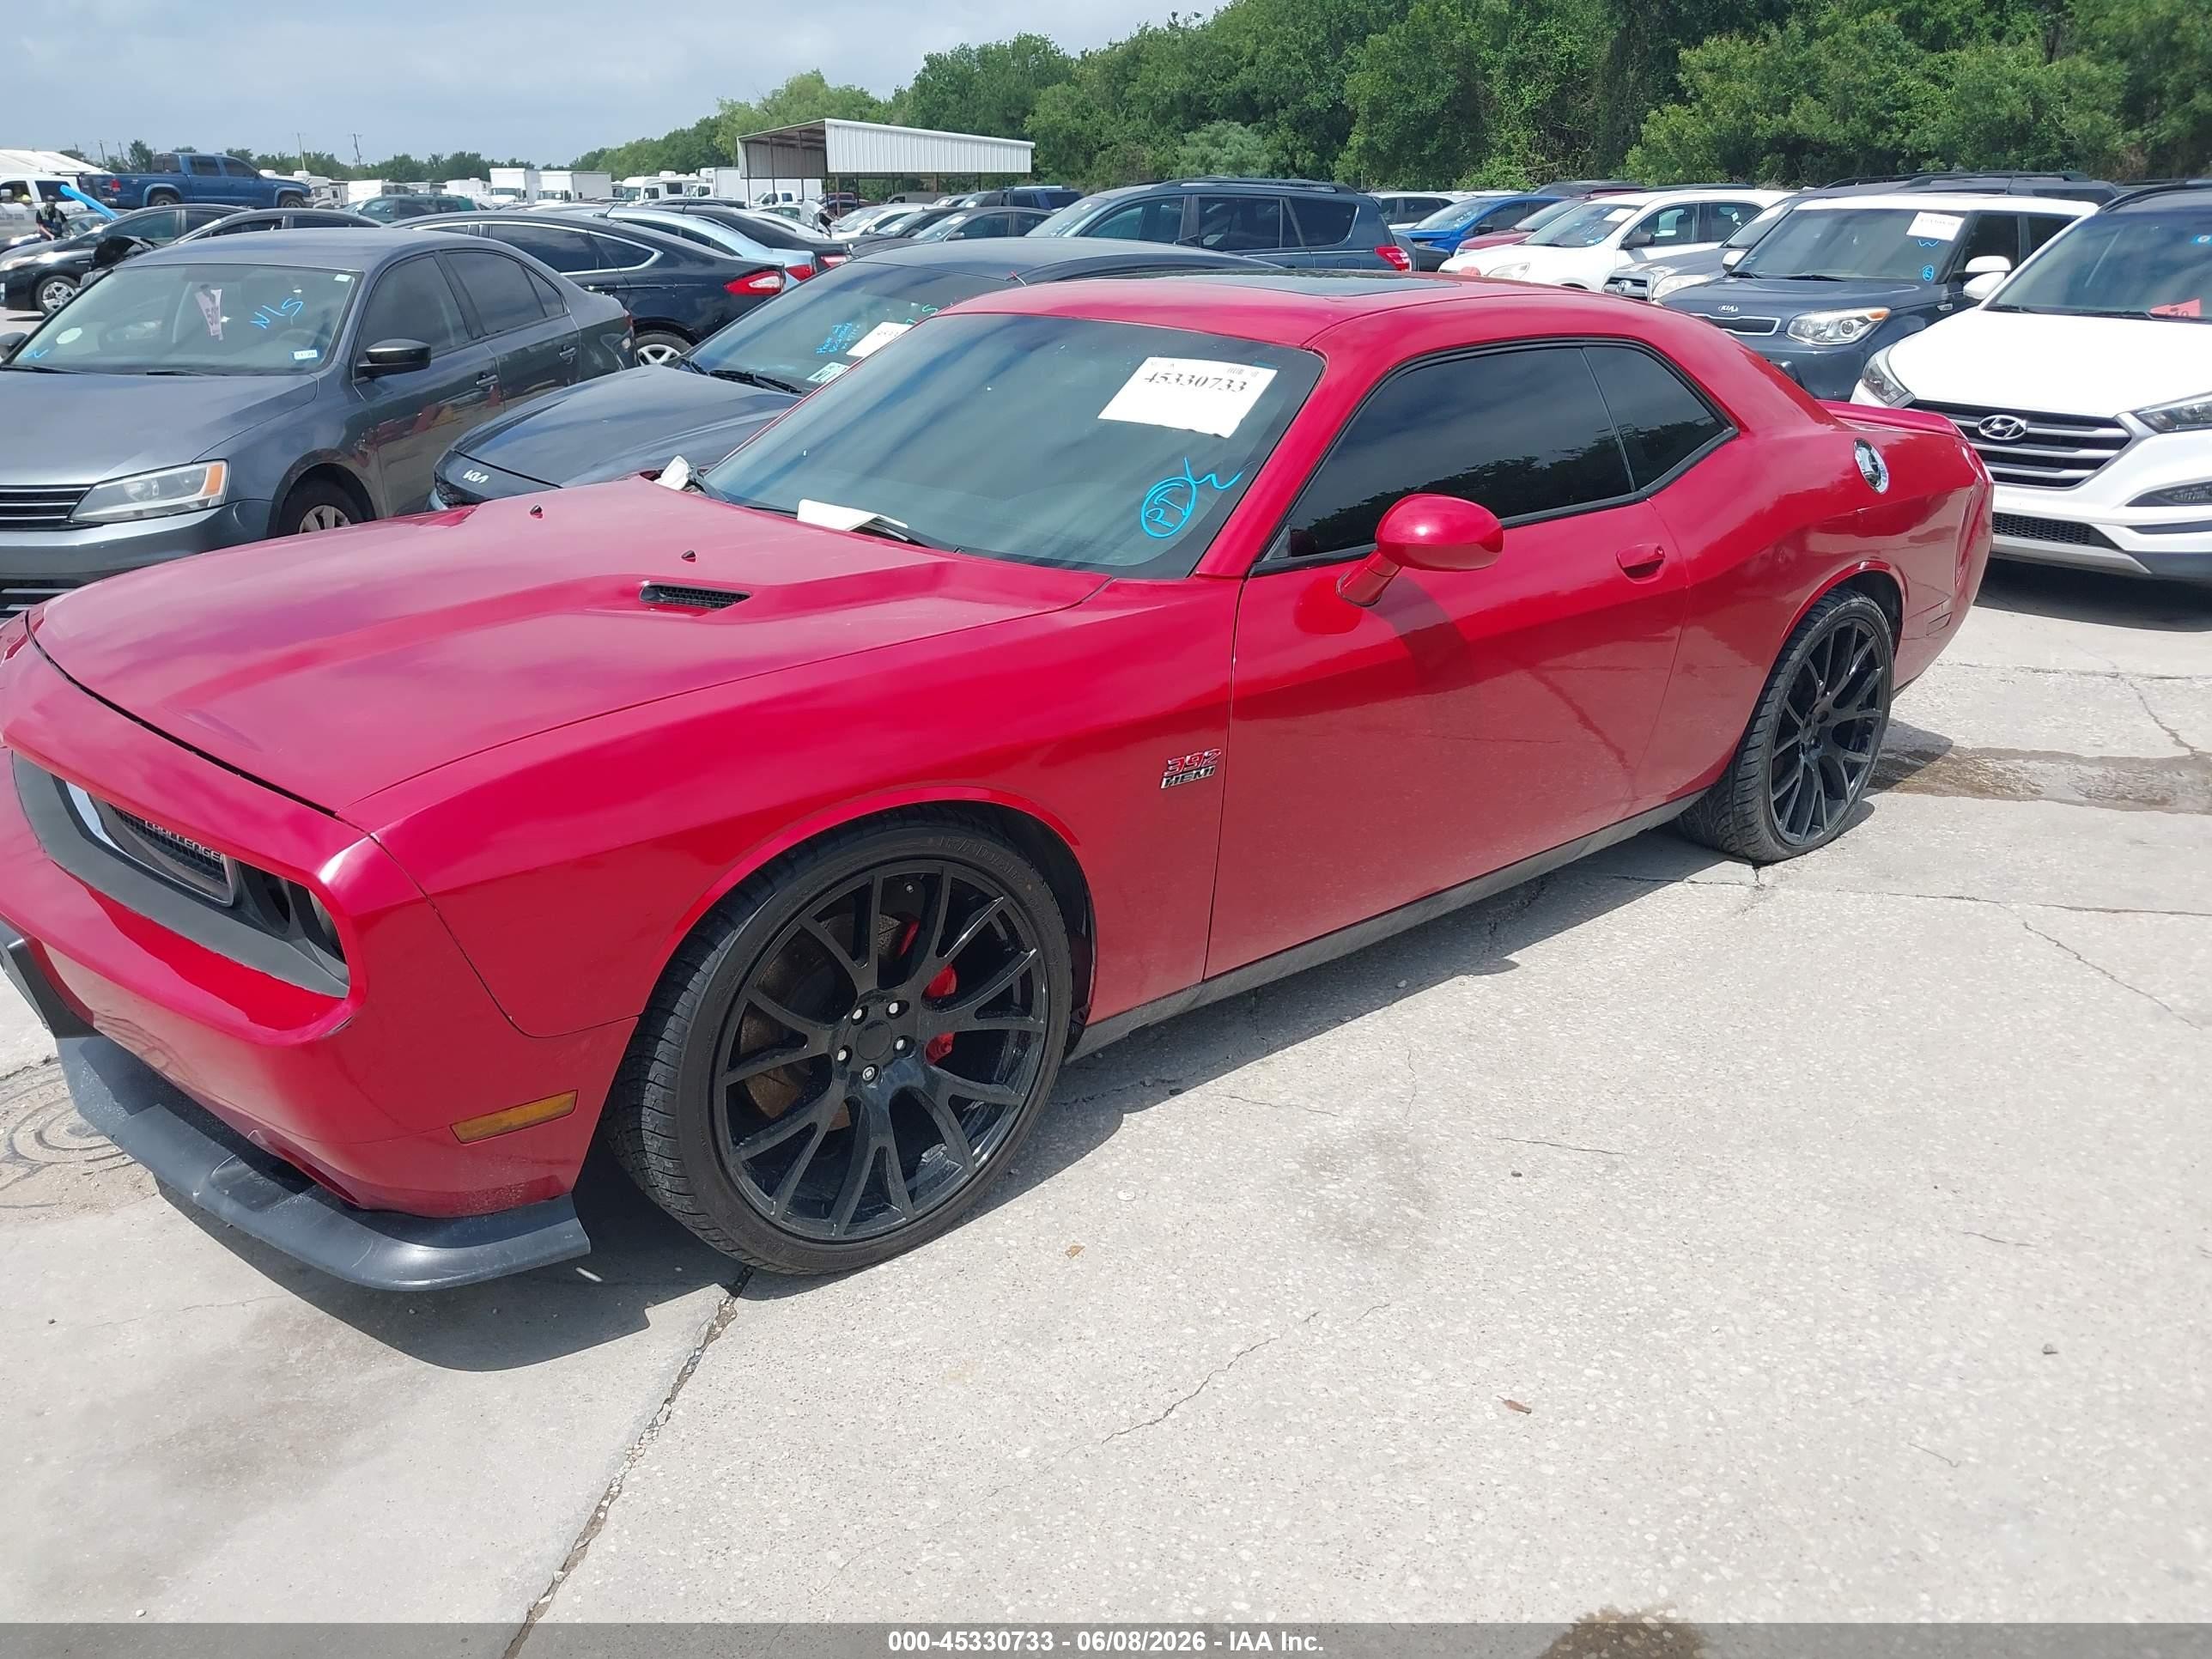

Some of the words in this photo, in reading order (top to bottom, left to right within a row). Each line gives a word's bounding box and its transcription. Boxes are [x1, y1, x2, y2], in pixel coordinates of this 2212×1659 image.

[1144, 372, 1248, 392] 45330733
[1163, 748, 1222, 777] 392
[1160, 765, 1217, 789] HEMI
